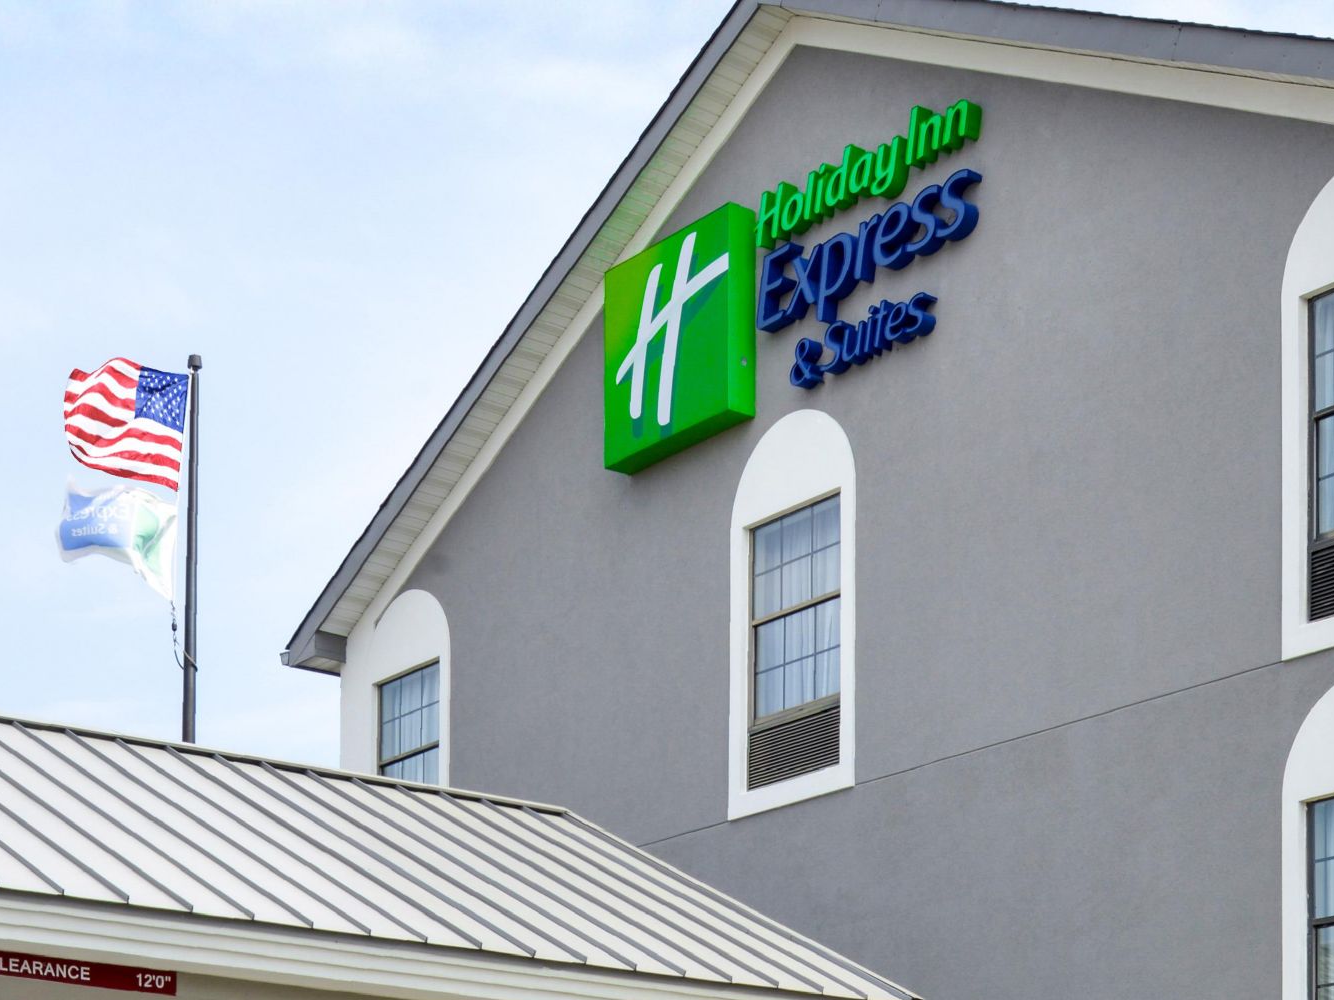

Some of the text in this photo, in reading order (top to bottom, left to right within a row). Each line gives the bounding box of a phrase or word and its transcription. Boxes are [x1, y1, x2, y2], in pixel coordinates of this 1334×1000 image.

[755, 99, 982, 248] Holiday Inn
[756, 168, 982, 333] Express
[616, 231, 729, 427] H
[789, 292, 938, 389] & Suites
[135, 973, 172, 989] 12'0"
